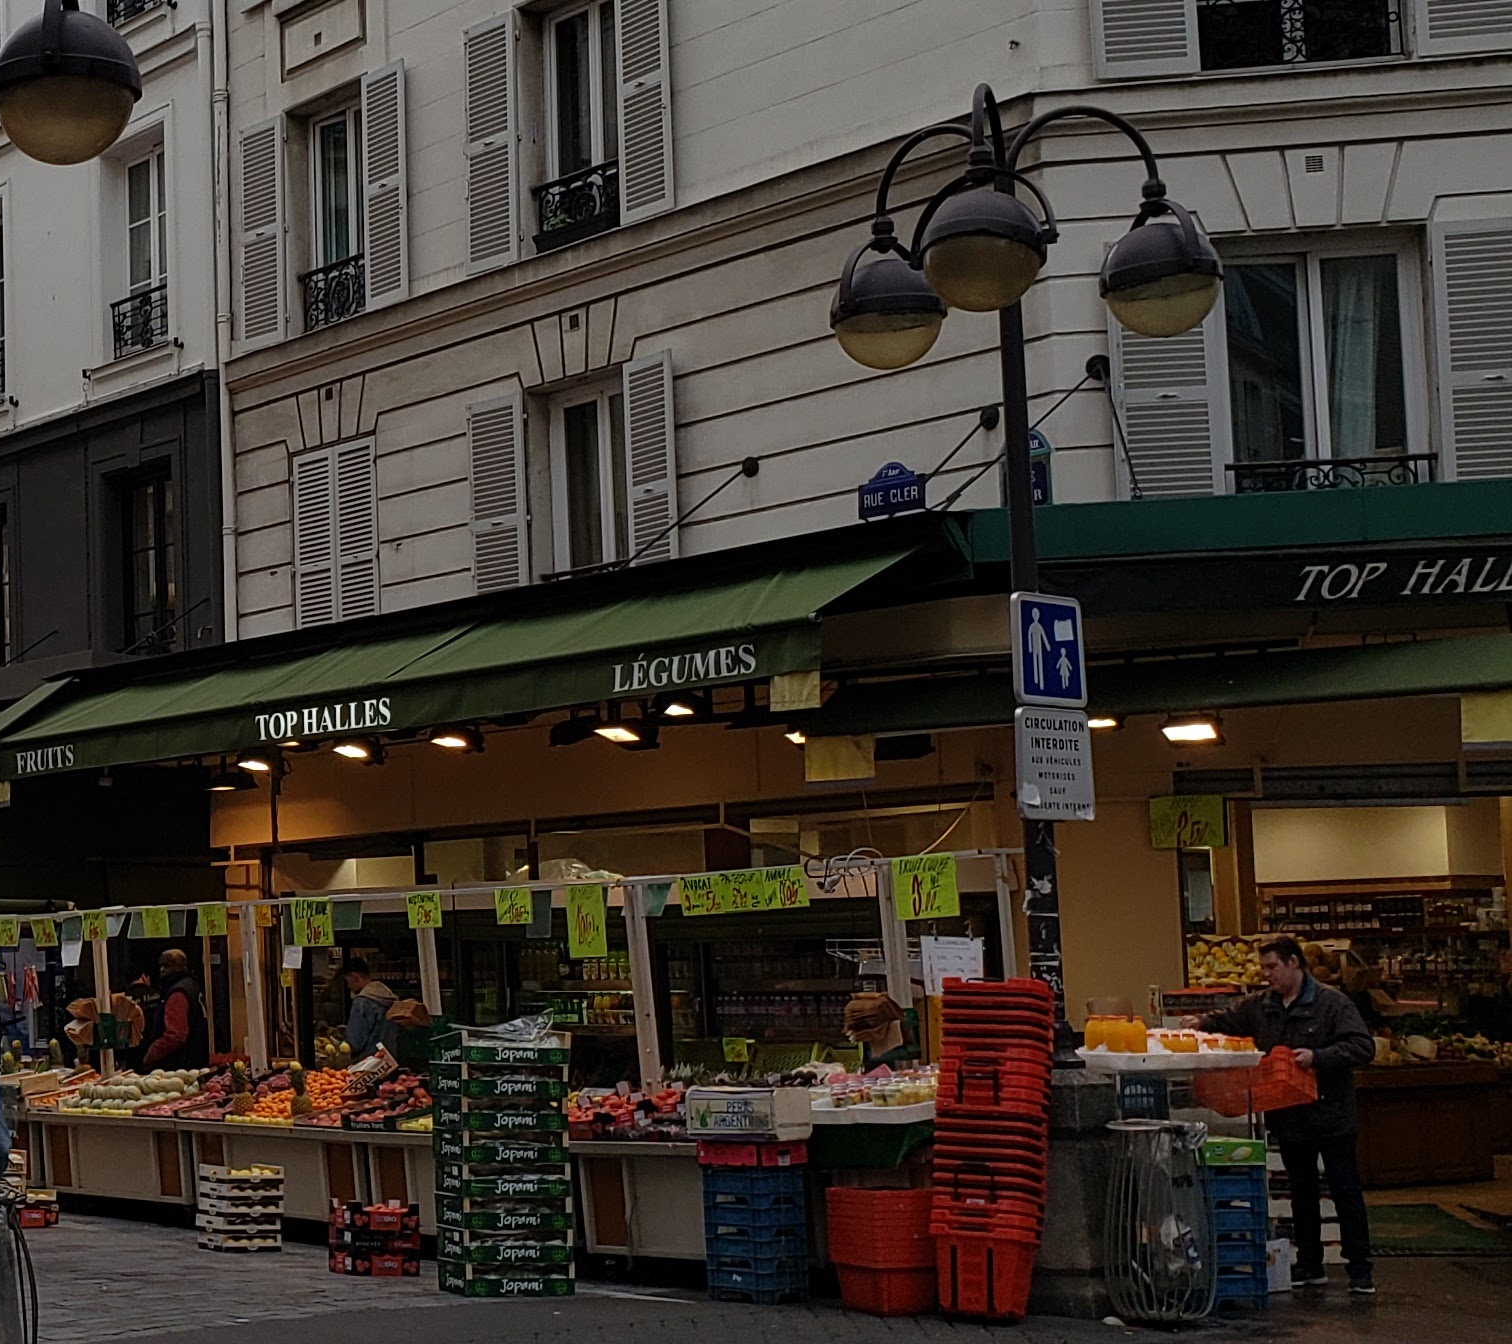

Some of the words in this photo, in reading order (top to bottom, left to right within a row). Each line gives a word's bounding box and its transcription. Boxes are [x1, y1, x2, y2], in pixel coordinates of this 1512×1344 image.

[863, 491, 885, 509] RUE
[890, 486, 919, 503] CLER
[1293, 562, 1388, 602] TOP
[612, 643, 757, 693] LÉGUMES
[254, 711, 298, 742] TOP
[301, 697, 392, 735] HALLES
[1024, 717, 1084, 732] CIRCULATION
[1031, 737, 1079, 751] INTERDITE
[15, 743, 75, 775] FRUITS
[1031, 756, 1043, 764] AUX
[1049, 787, 1066, 795] SAUF
[681, 877, 711, 891] AVOCAT
[495, 1048, 538, 1062] Jopami
[494, 1081, 536, 1096] Jopami
[494, 1114, 536, 1128] Jopami
[495, 1147, 538, 1162] Jopami
[494, 1180, 537, 1195] Jopami
[497, 1213, 540, 1228] Jopami
[497, 1246, 540, 1261] Jopami
[500, 1278, 543, 1293] Jopami
